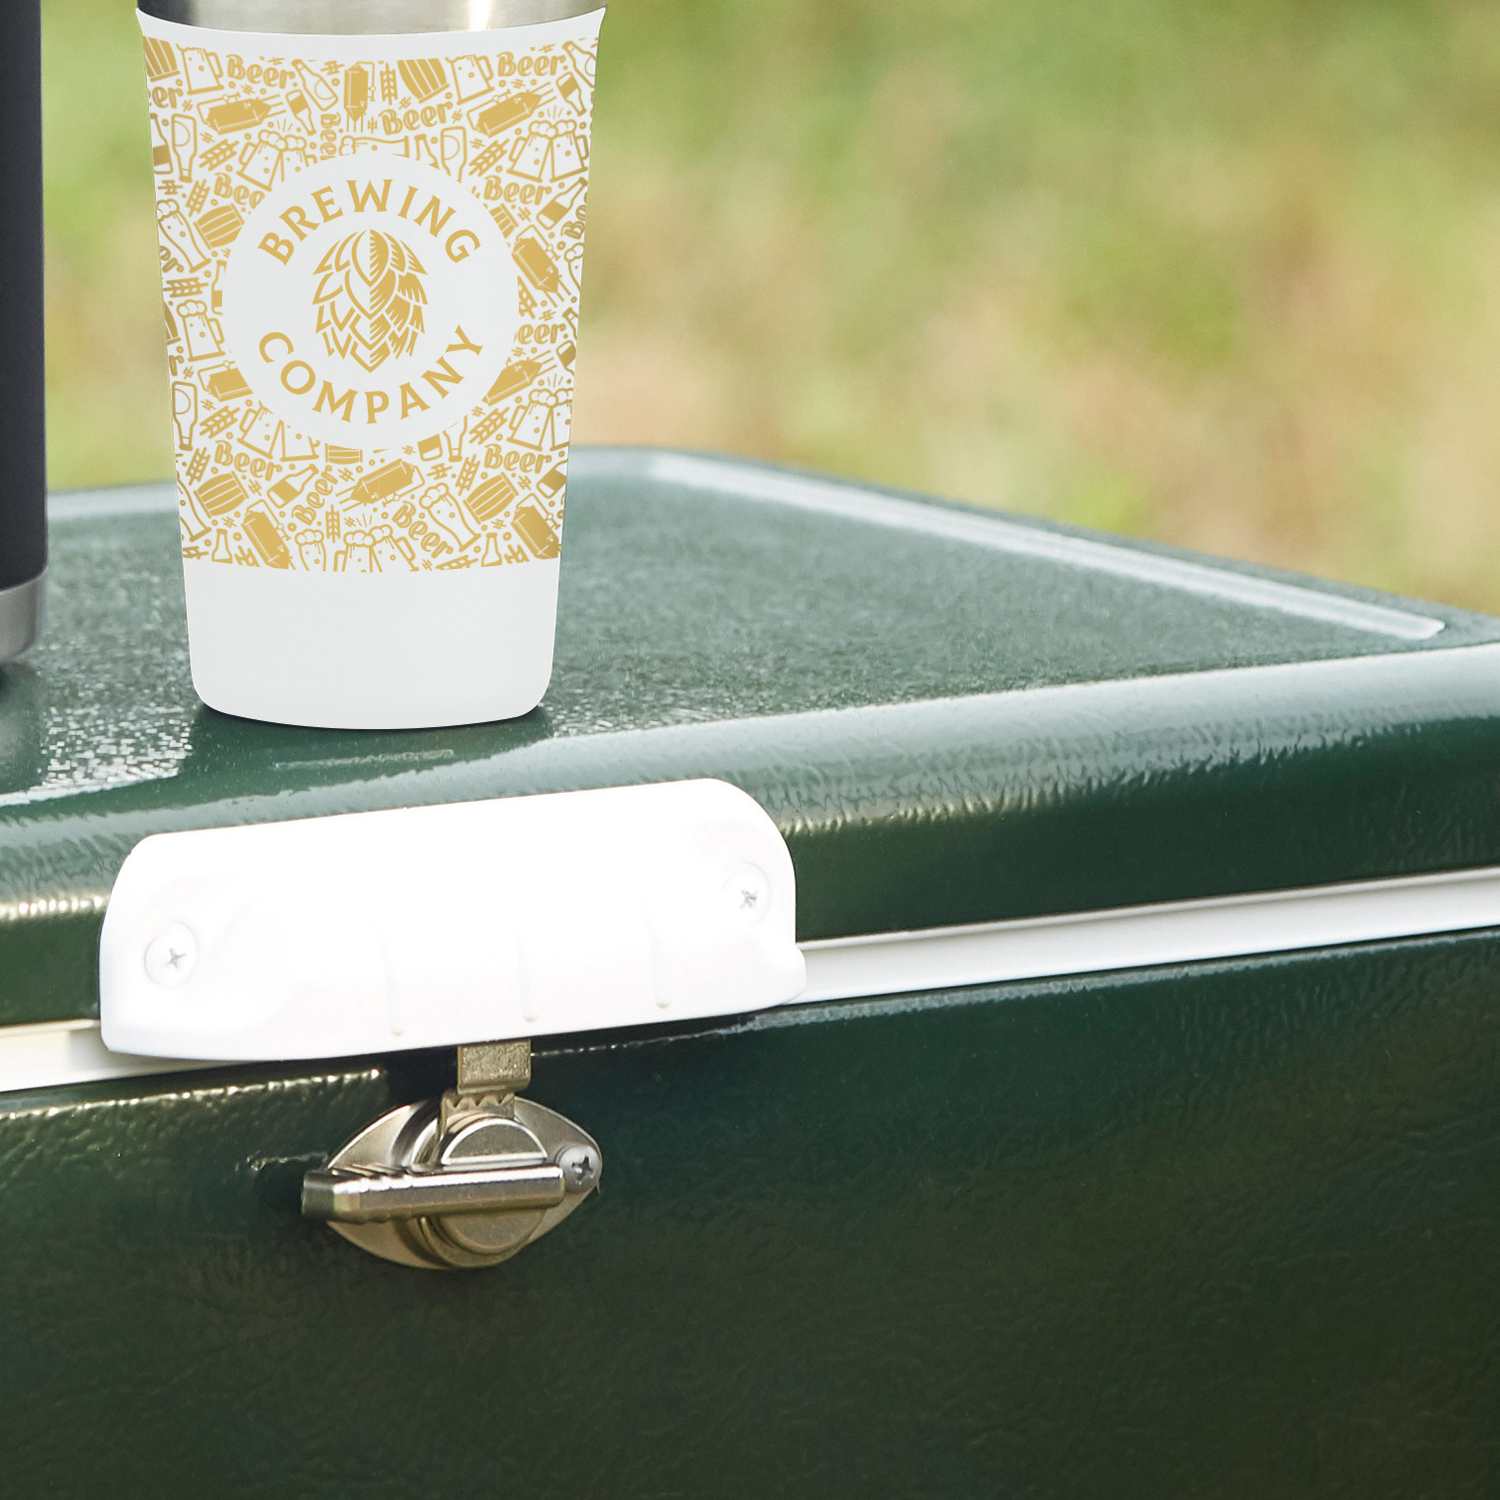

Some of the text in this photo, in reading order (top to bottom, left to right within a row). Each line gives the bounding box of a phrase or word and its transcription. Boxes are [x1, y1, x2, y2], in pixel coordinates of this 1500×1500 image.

[226, 54, 295, 89] Beer
[499, 52, 566, 77] Beer
[320, 112, 341, 160] Bee
[378, 101, 453, 136] Beer
[213, 172, 265, 209] Bee
[484, 175, 552, 206] Beer
[258, 179, 481, 266] BREWING
[513, 323, 567, 345] eer
[259, 325, 484, 424] COMPANY
[214, 440, 283, 481] Beer
[484, 443, 552, 474] Beer
[292, 465, 338, 525] Beer
[392, 501, 454, 559] Beer
